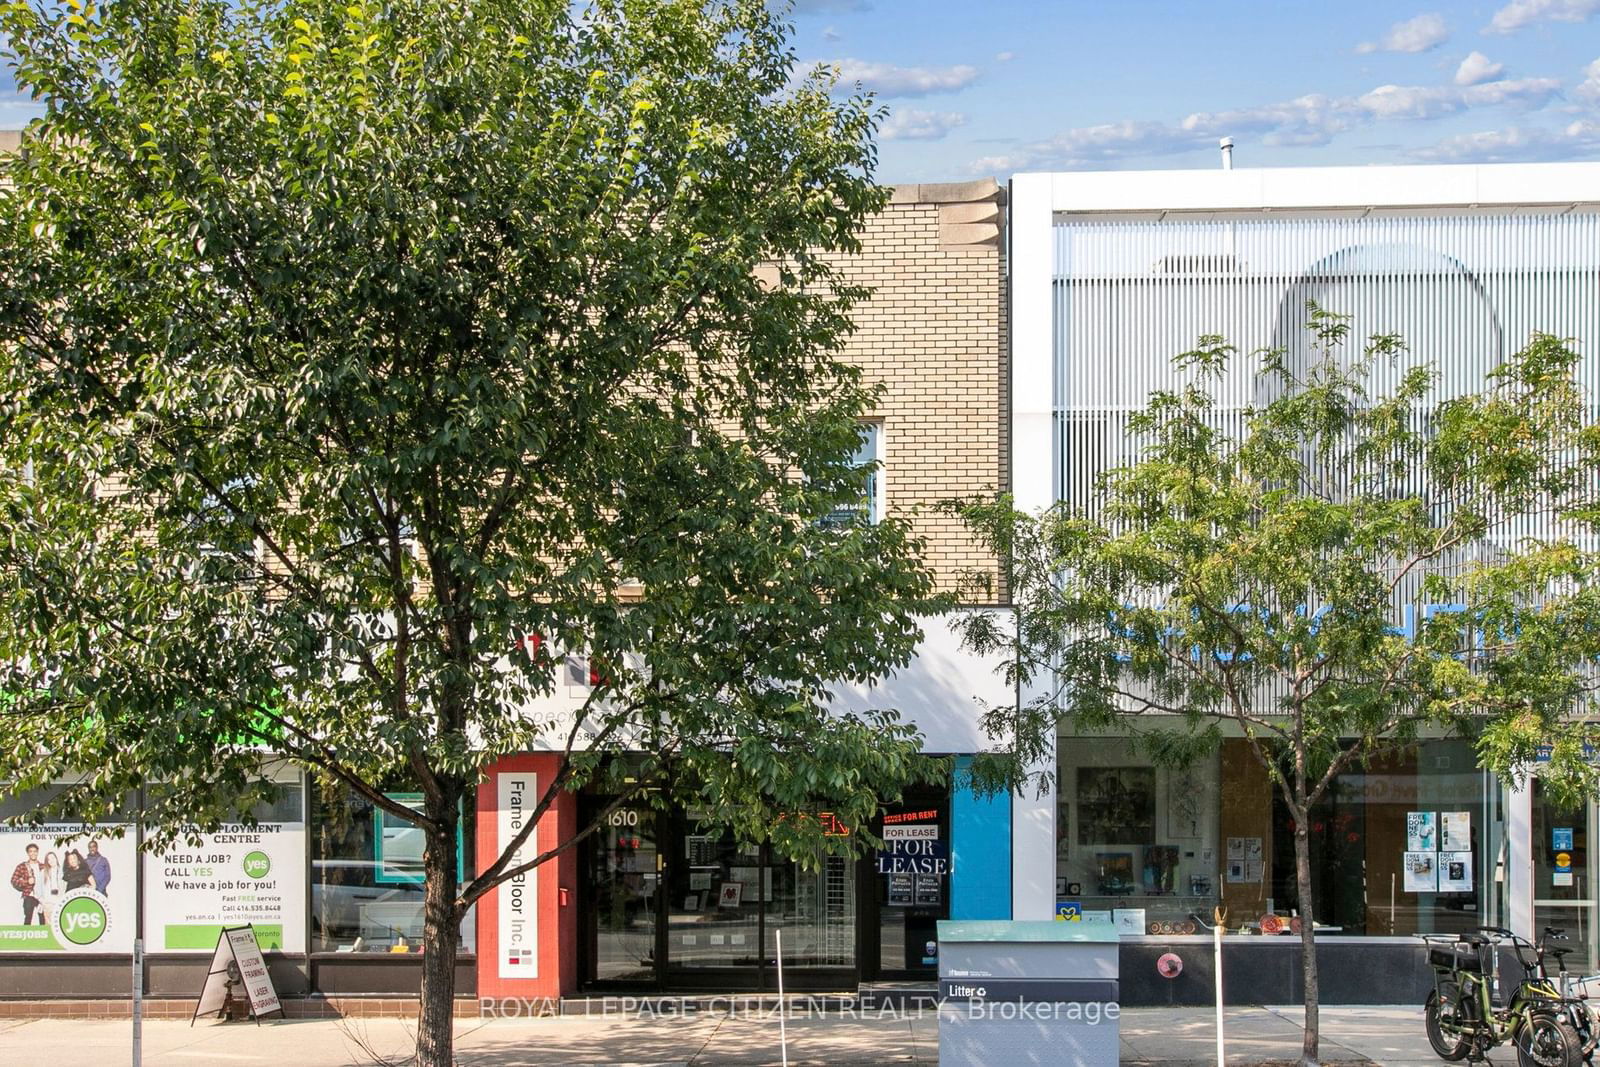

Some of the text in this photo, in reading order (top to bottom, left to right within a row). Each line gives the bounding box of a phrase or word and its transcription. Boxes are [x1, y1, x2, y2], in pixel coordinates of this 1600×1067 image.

[511, 781, 525, 829] Frame
[608, 810, 638, 826] 1610
[902, 810, 937, 821] FOR RENT
[213, 835, 261, 844] CENTRE
[885, 829, 936, 837] FOR LEASE
[892, 840, 935, 856] FOR
[164, 854, 232, 864] NEED A JOB?
[246, 859, 268, 872] yes
[164, 867, 214, 877] CALL YES
[878, 857, 947, 875] LEASE
[164, 880, 277, 892] We have a job for you!
[511, 870, 526, 914] Bloor
[65, 911, 101, 933] yes
[511, 919, 526, 946] Inc.
[949, 985, 976, 997] Litter
